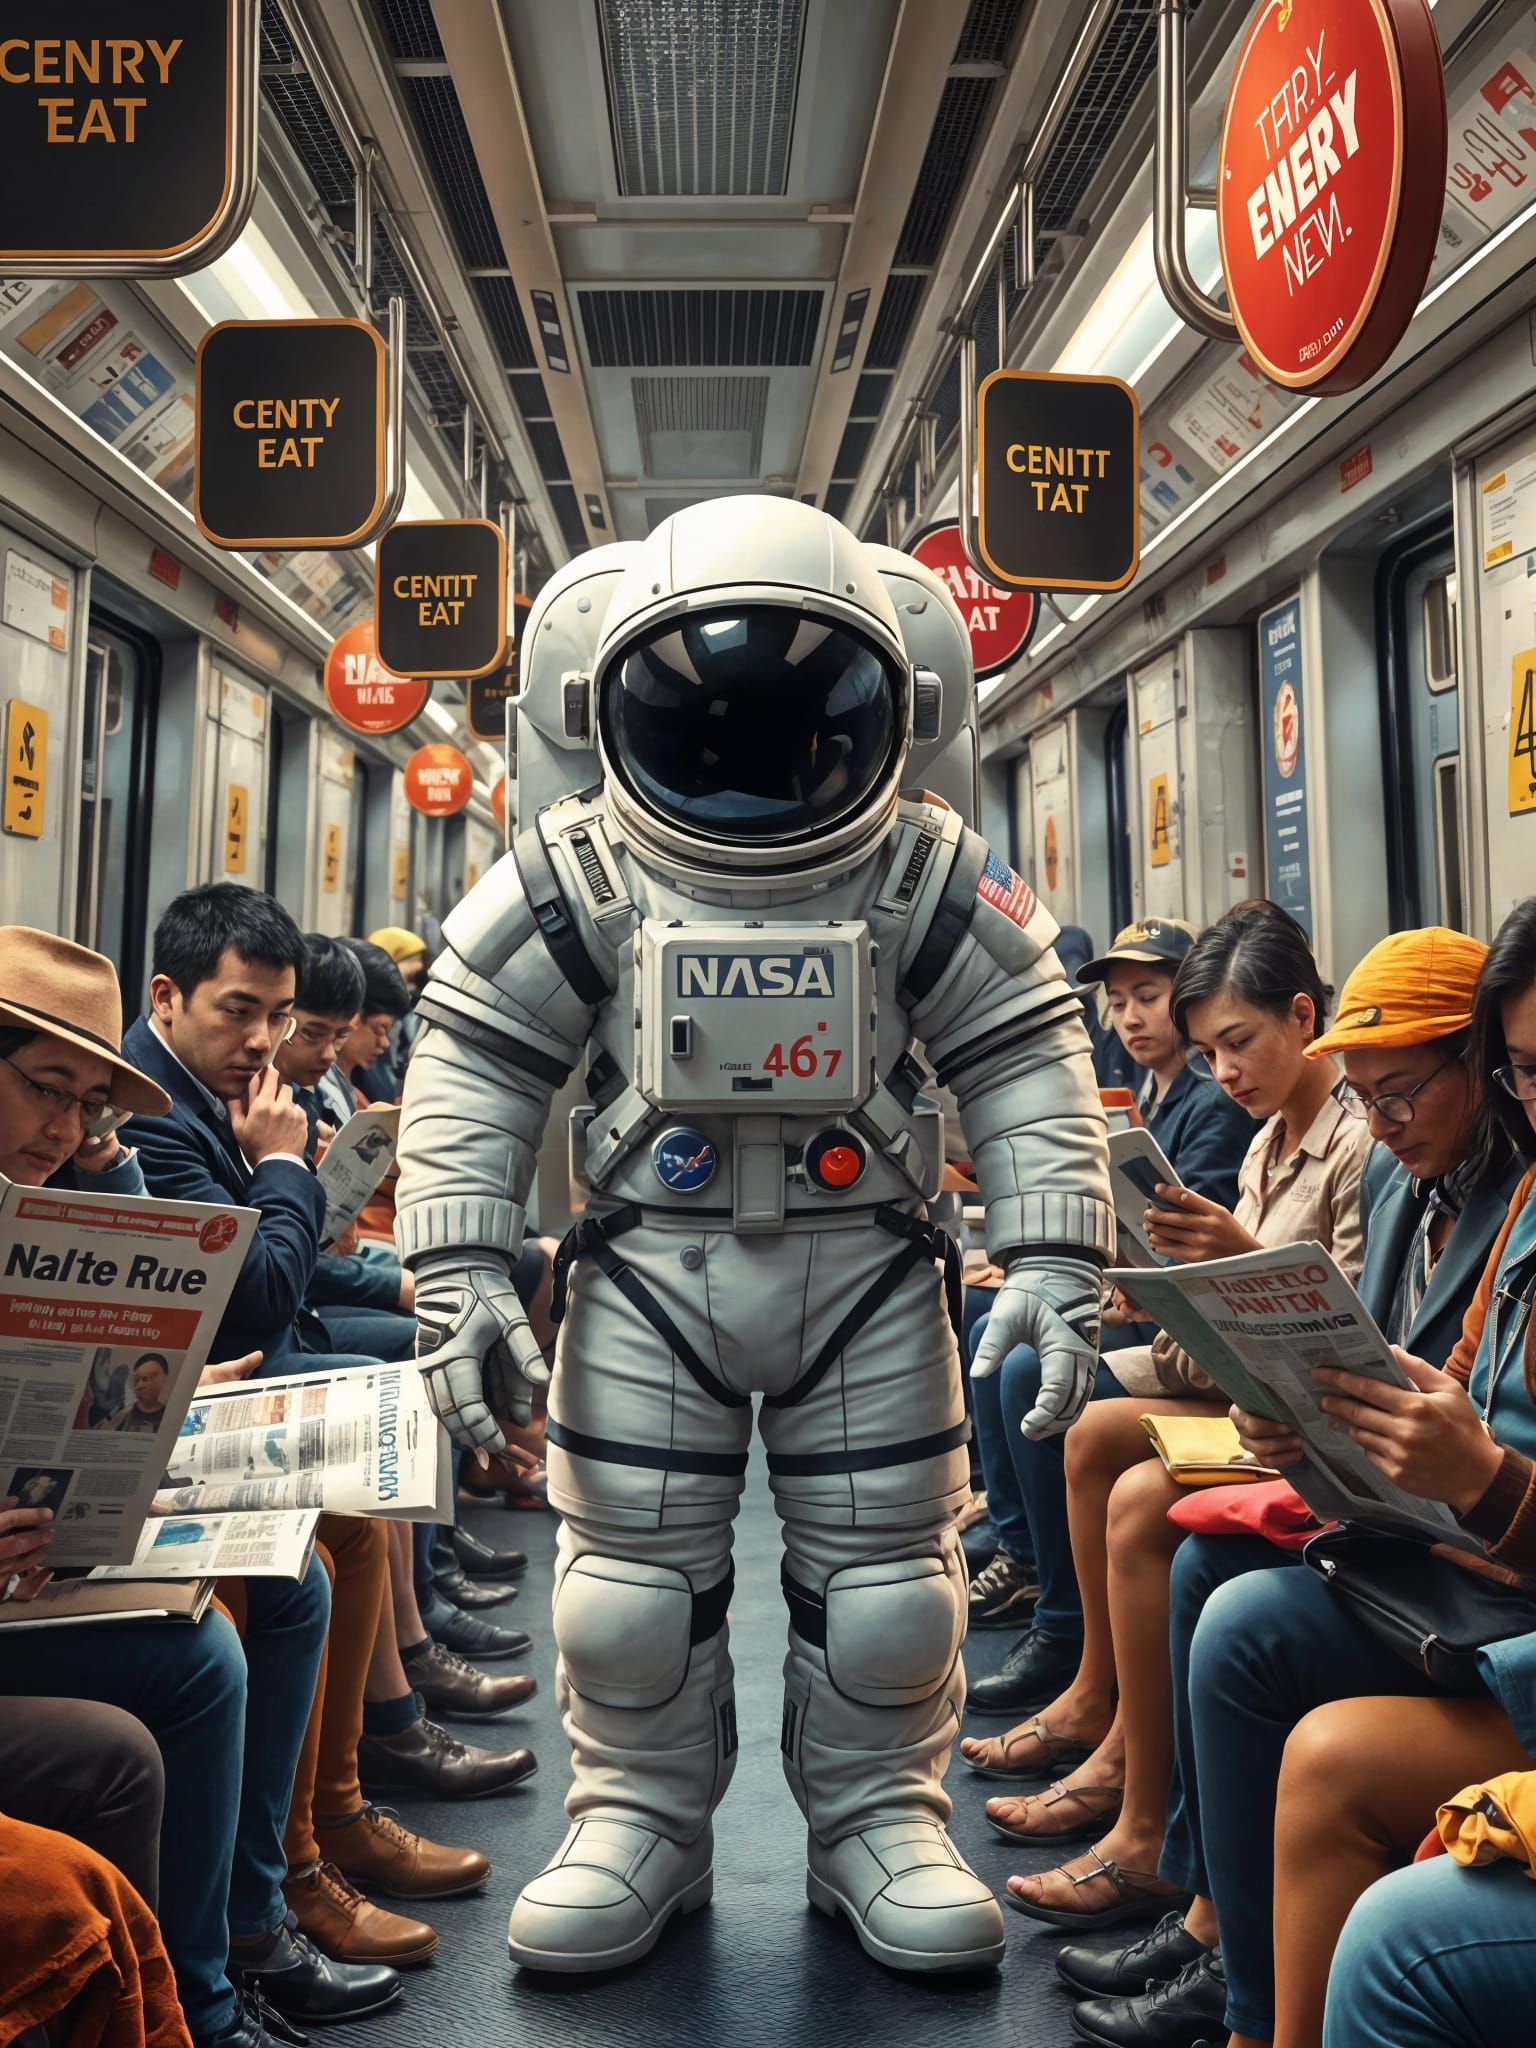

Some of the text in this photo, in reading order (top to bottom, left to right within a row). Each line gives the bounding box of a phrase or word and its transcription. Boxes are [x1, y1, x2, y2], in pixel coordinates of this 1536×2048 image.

[38, 97, 147, 143] EAT
[1247, 68, 1360, 261] ENERY
[233, 397, 340, 429] CENTY
[258, 437, 324, 468] EAT
[1006, 443, 1111, 479] CENITT
[1031, 481, 1089, 513] TAT
[393, 574, 478, 599] CENTIT
[419, 601, 465, 626] EAT
[682, 957, 833, 996] NASA
[763, 1035, 842, 1078] 467
[125, 1254, 207, 1295] Rue
